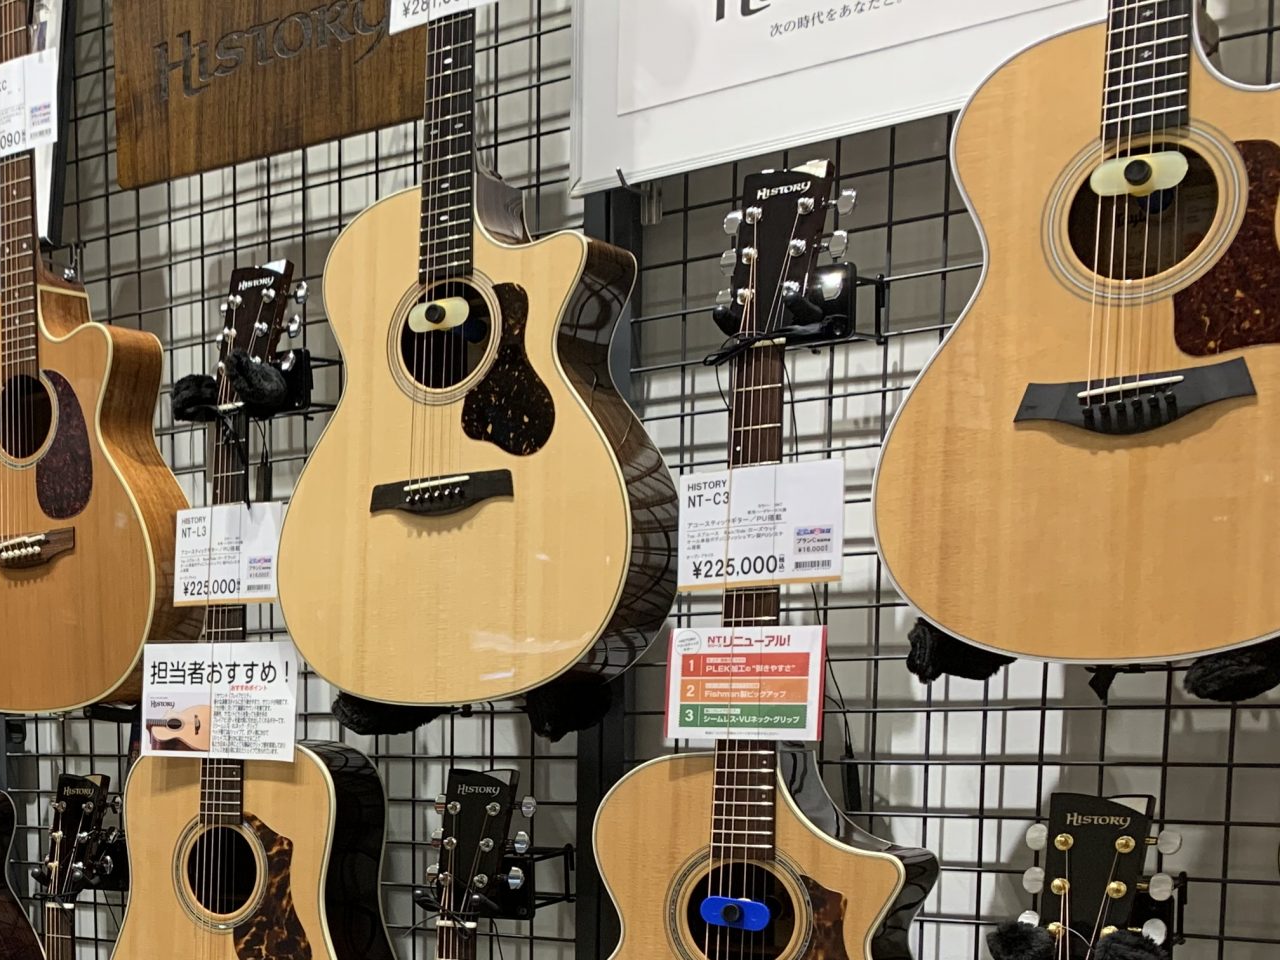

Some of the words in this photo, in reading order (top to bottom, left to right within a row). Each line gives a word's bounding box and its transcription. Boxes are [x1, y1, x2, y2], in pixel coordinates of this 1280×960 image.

[757, 181, 811, 200] HISTORY
[238, 276, 274, 291] HISTORY
[687, 480, 727, 492] HISTORY
[688, 491, 729, 508] NT-C3
[181, 516, 207, 525] HISTORY
[181, 526, 207, 539] NT-L3
[693, 555, 778, 579] ¥225,000
[688, 660, 694, 671] 1
[686, 685, 695, 697] 2
[685, 709, 694, 721] 3
[63, 786, 94, 798] HISTORY
[457, 784, 501, 797] HISTORY
[1066, 812, 1131, 830] HISTORY
